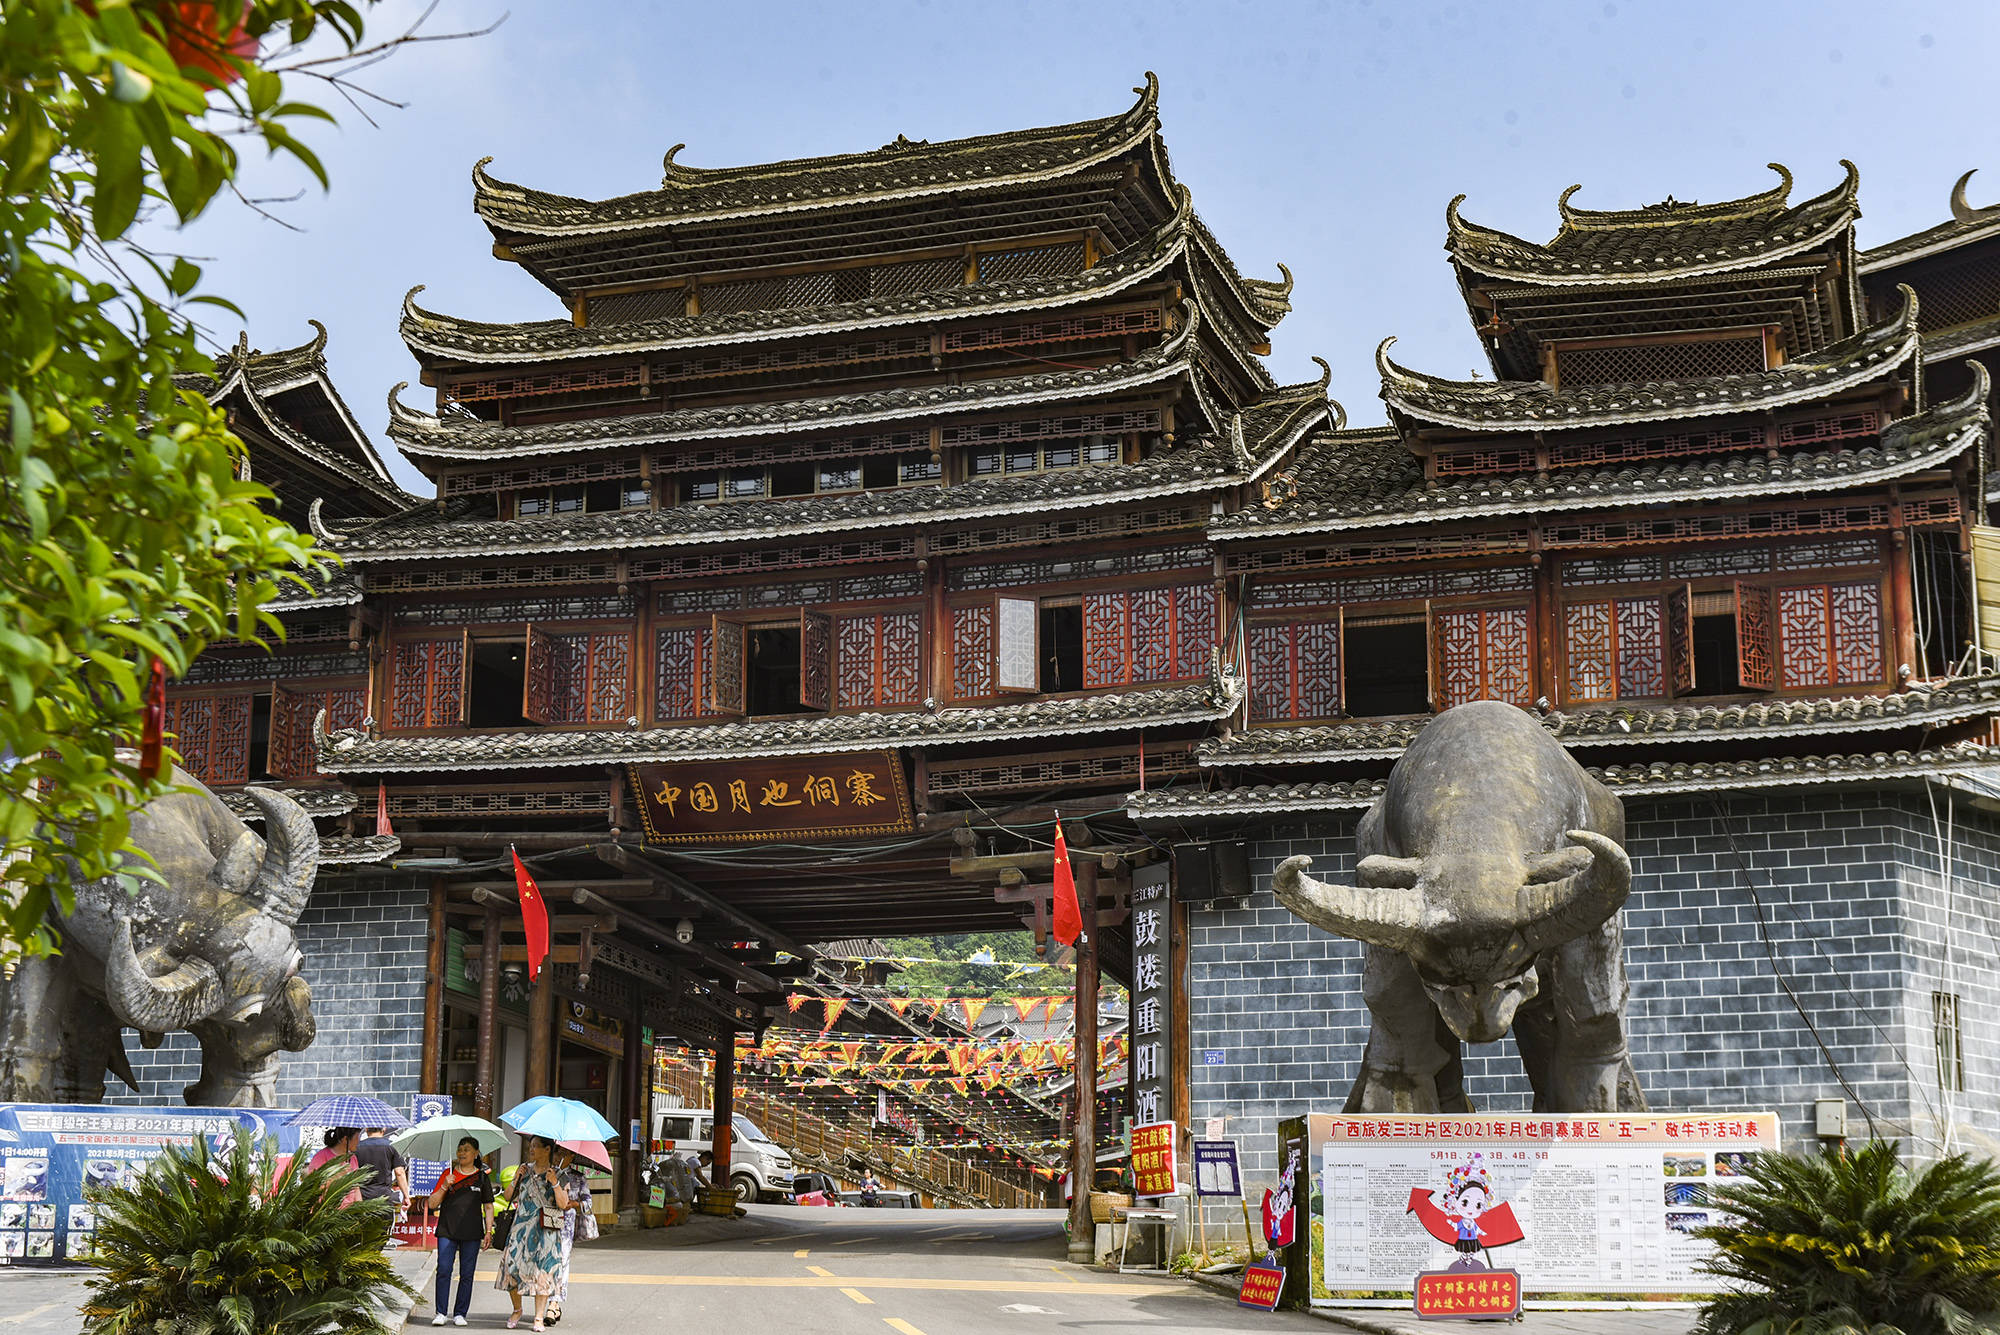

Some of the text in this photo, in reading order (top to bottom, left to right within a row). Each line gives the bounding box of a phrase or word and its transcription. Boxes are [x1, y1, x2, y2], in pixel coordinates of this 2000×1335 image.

[654, 769, 887, 818] 中国月也侗寨
[1135, 910, 1162, 1125] 鼓楼重阳酒
[1132, 1128, 1169, 1149] 三江鼓楼
[1132, 1150, 1169, 1171] 重阳酒厂
[1137, 1171, 1172, 1192] 厂家直销
